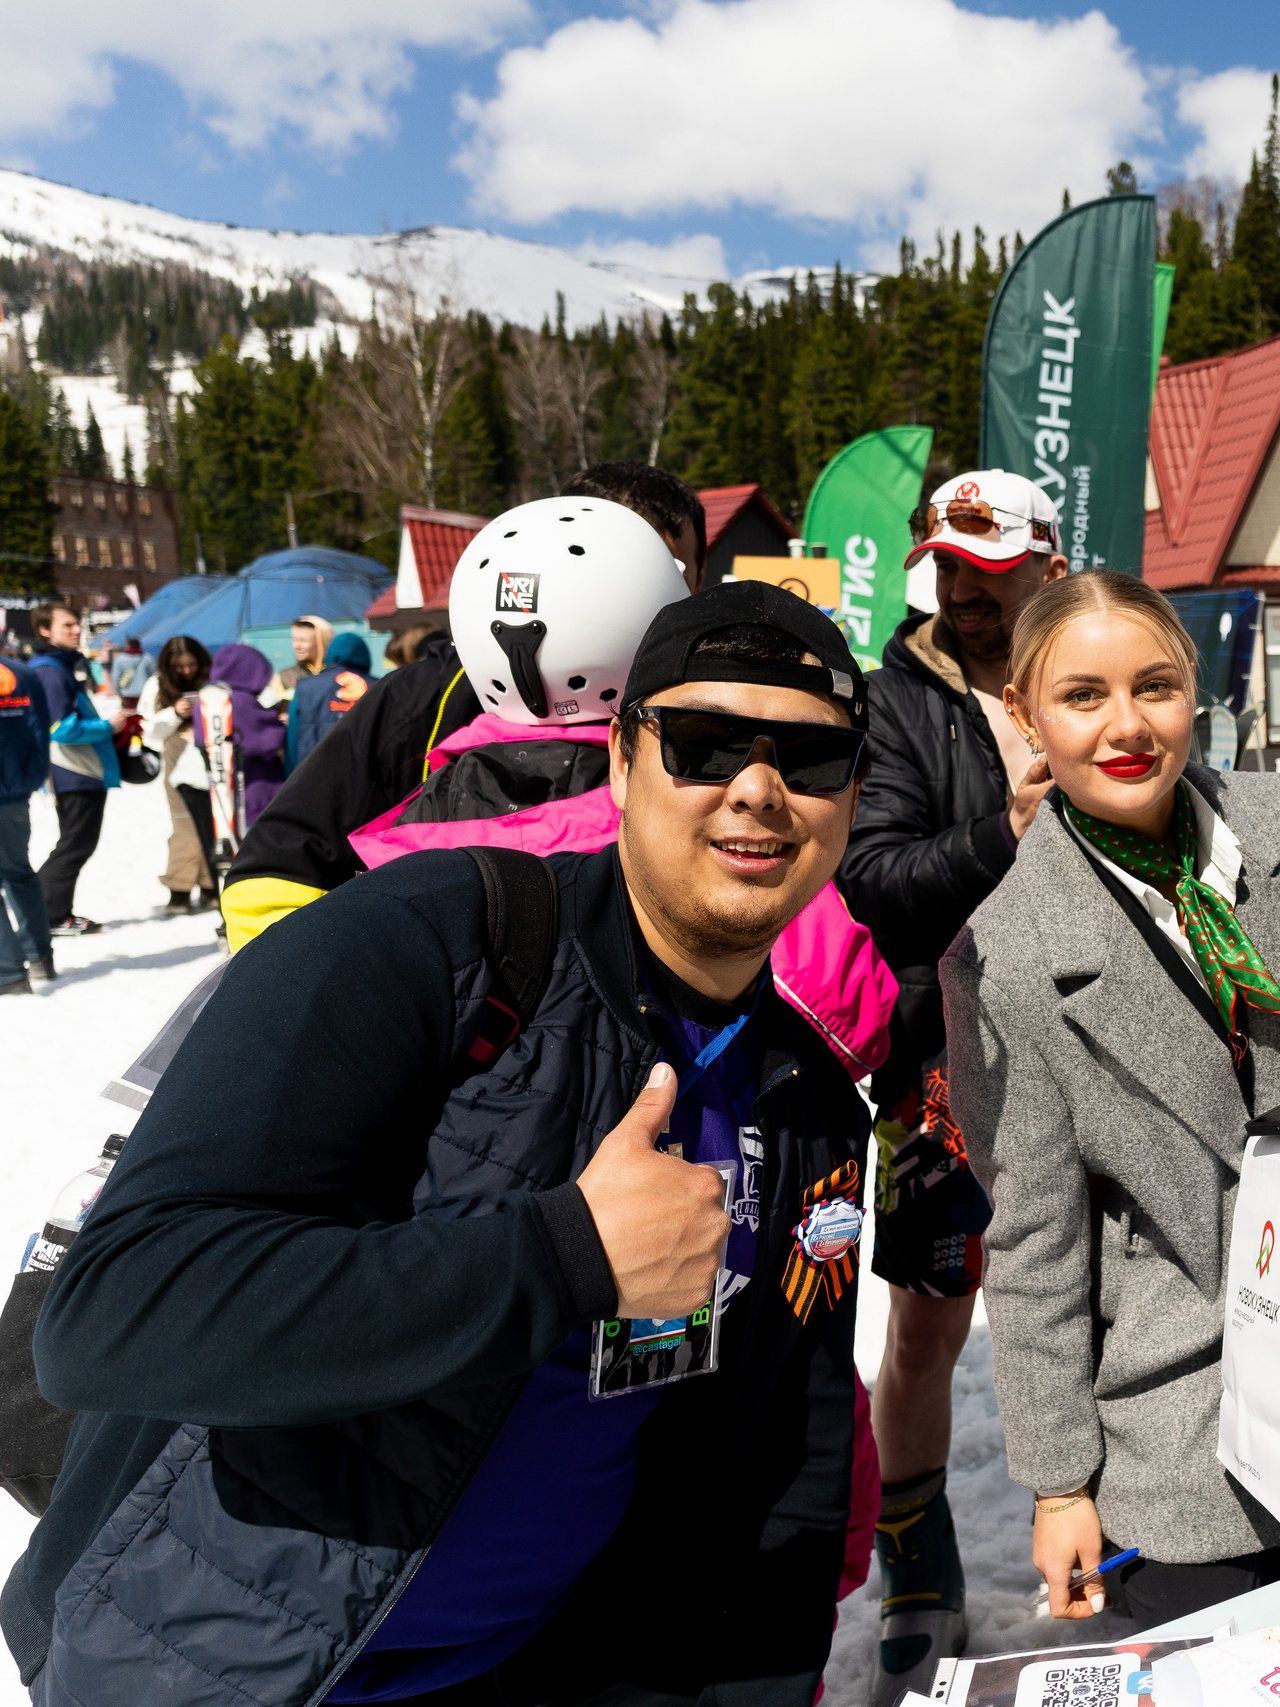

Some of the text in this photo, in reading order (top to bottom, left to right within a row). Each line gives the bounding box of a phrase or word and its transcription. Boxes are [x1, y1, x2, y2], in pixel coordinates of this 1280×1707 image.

[1033, 289, 1081, 524] УЗНЕЦК
[841, 534, 878, 647] 2ГИС
[213, 715, 226, 784] HEAD
[1237, 1284, 1280, 1324] НОВОКУЗНЕЦК
[632, 1335, 682, 1356] @castagal
